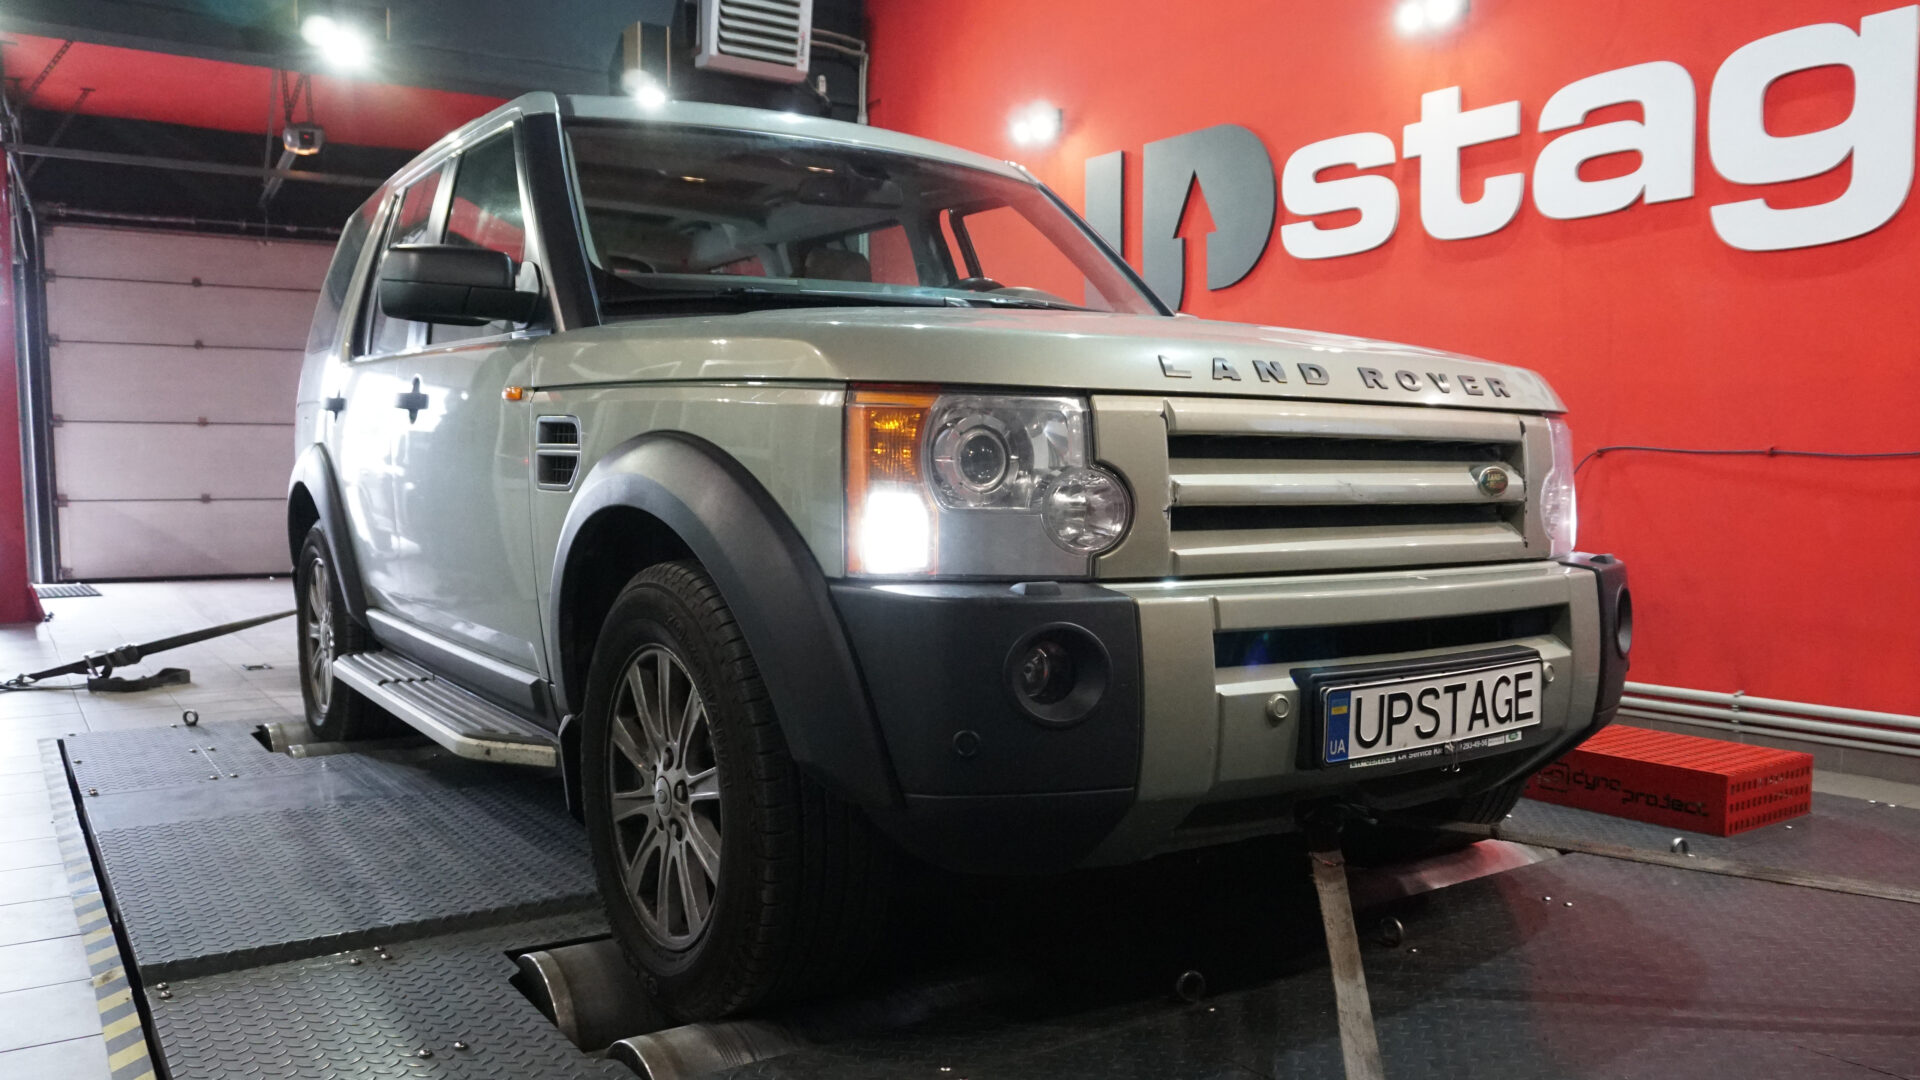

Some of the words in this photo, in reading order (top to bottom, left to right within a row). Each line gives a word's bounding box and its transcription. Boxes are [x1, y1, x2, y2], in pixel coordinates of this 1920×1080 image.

[1158, 354, 1330, 386] LAND
[1357, 366, 1511, 398] ROVER
[1355, 671, 1534, 749] UPSTAGE
[1330, 739, 1346, 756] UA
